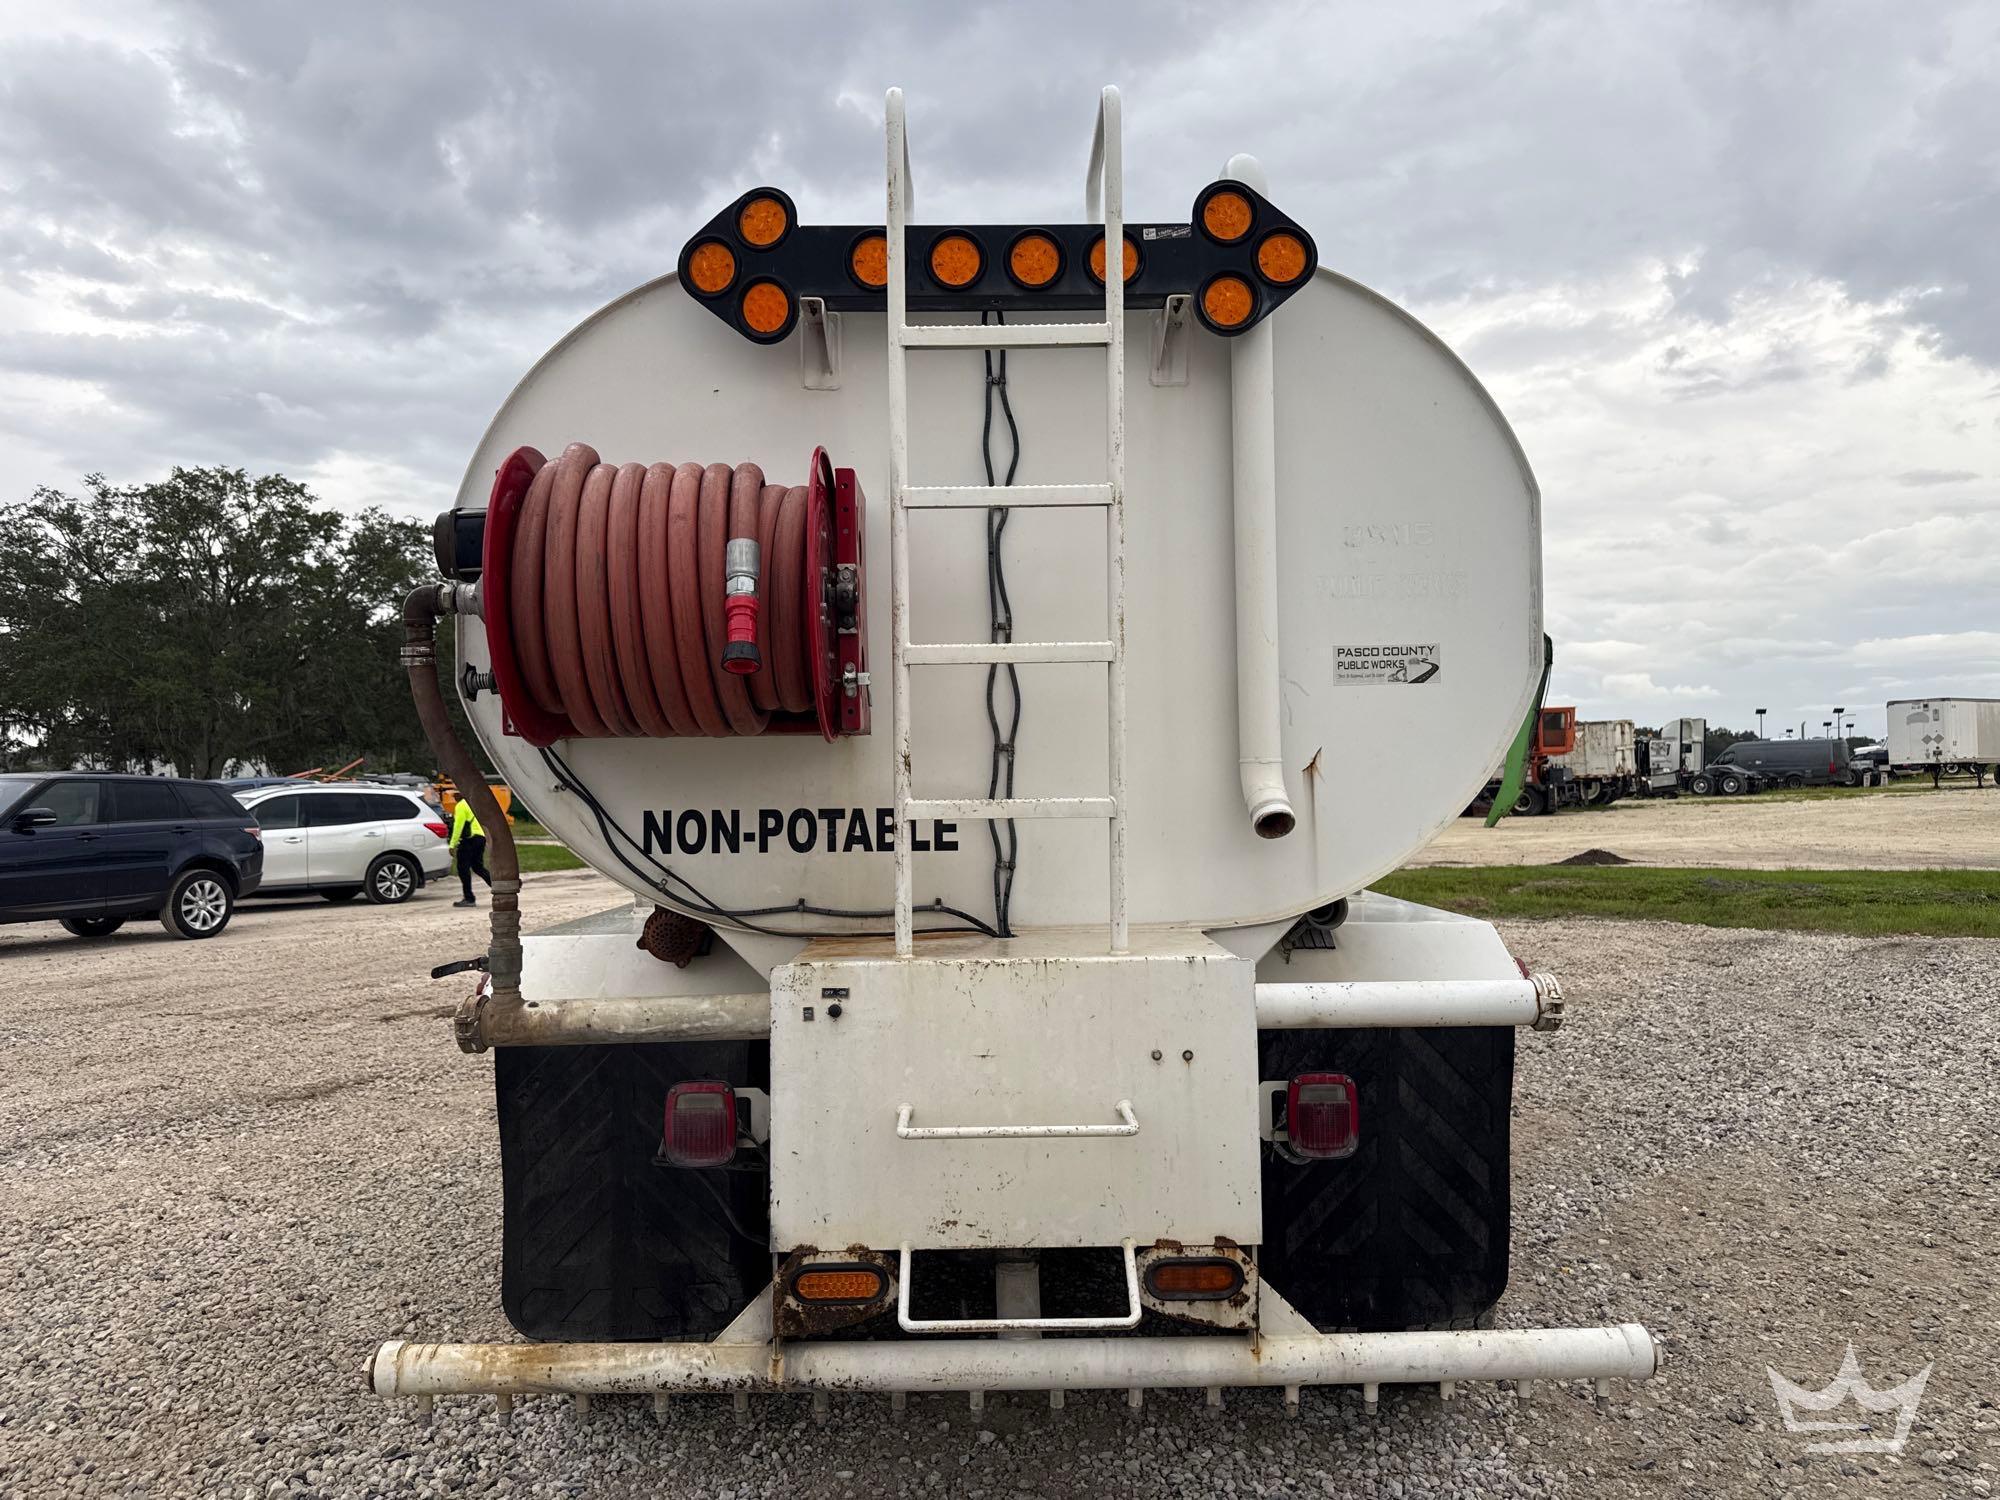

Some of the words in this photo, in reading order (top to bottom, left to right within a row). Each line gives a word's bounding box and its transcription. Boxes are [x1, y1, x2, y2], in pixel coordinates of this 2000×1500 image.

[1337, 647, 1380, 657] PASCO
[1382, 645, 1436, 656] COUNTY
[1337, 660, 1369, 670] PUBLIC
[1371, 659, 1405, 669] WORKS
[643, 807, 959, 854] NON-POTABLE
